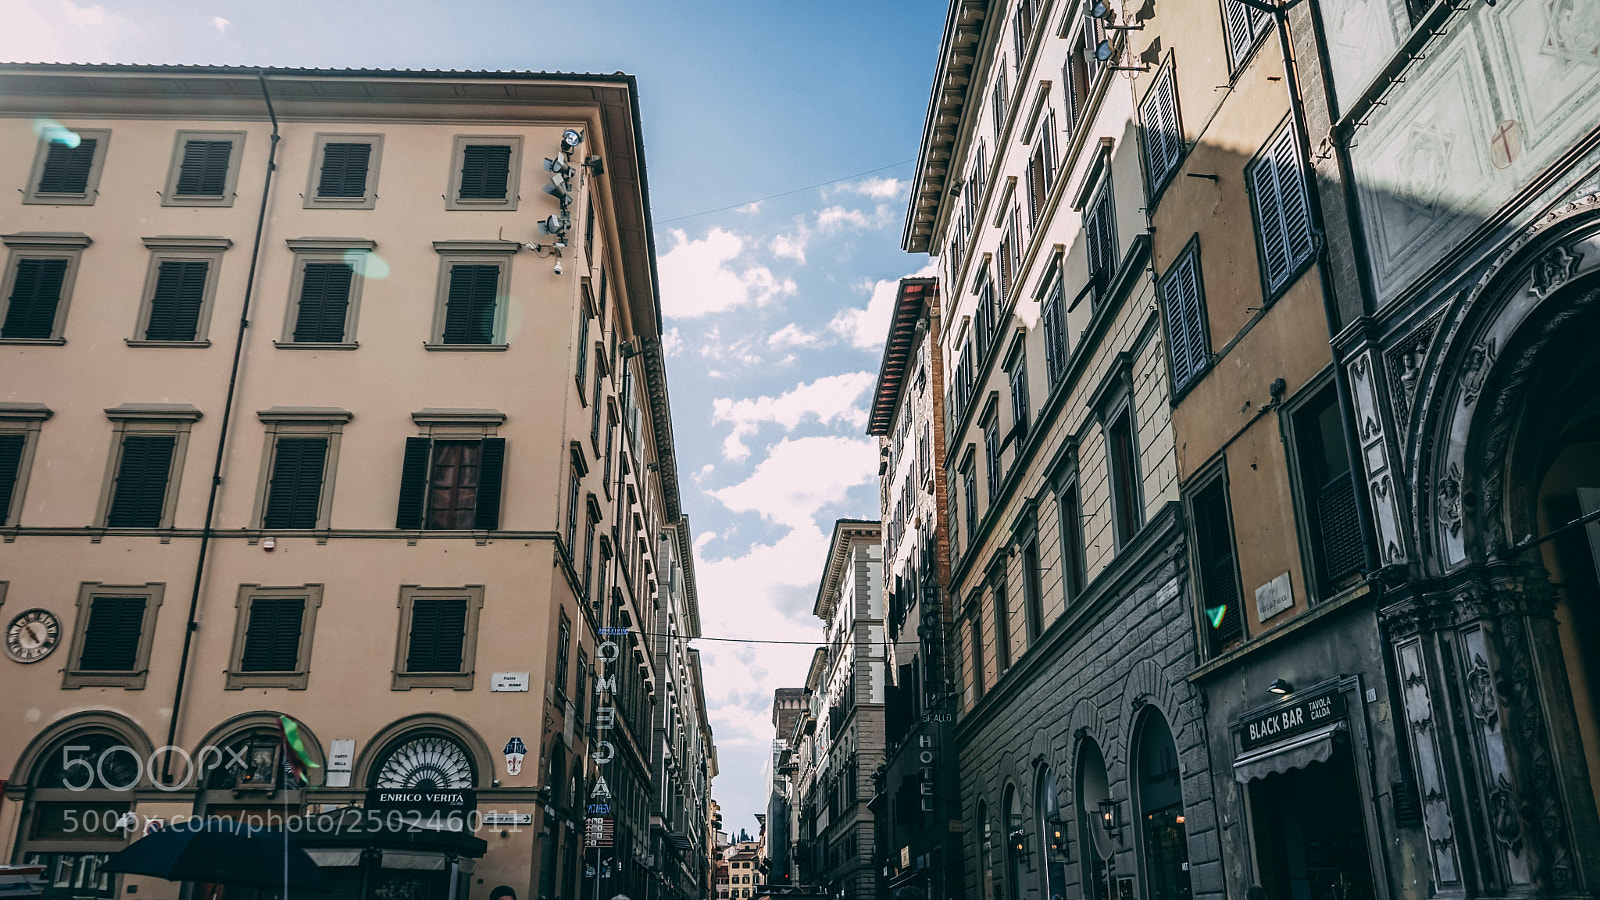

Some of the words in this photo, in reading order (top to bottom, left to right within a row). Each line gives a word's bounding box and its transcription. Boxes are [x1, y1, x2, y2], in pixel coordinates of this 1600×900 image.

[1308, 696, 1332, 712] TAVOLA
[1310, 706, 1331, 721] CALDA
[1249, 715, 1281, 740] BLACK
[1282, 707, 1304, 730] BAR
[920, 735, 934, 812] HOTEL
[380, 793, 422, 802] ENRICO
